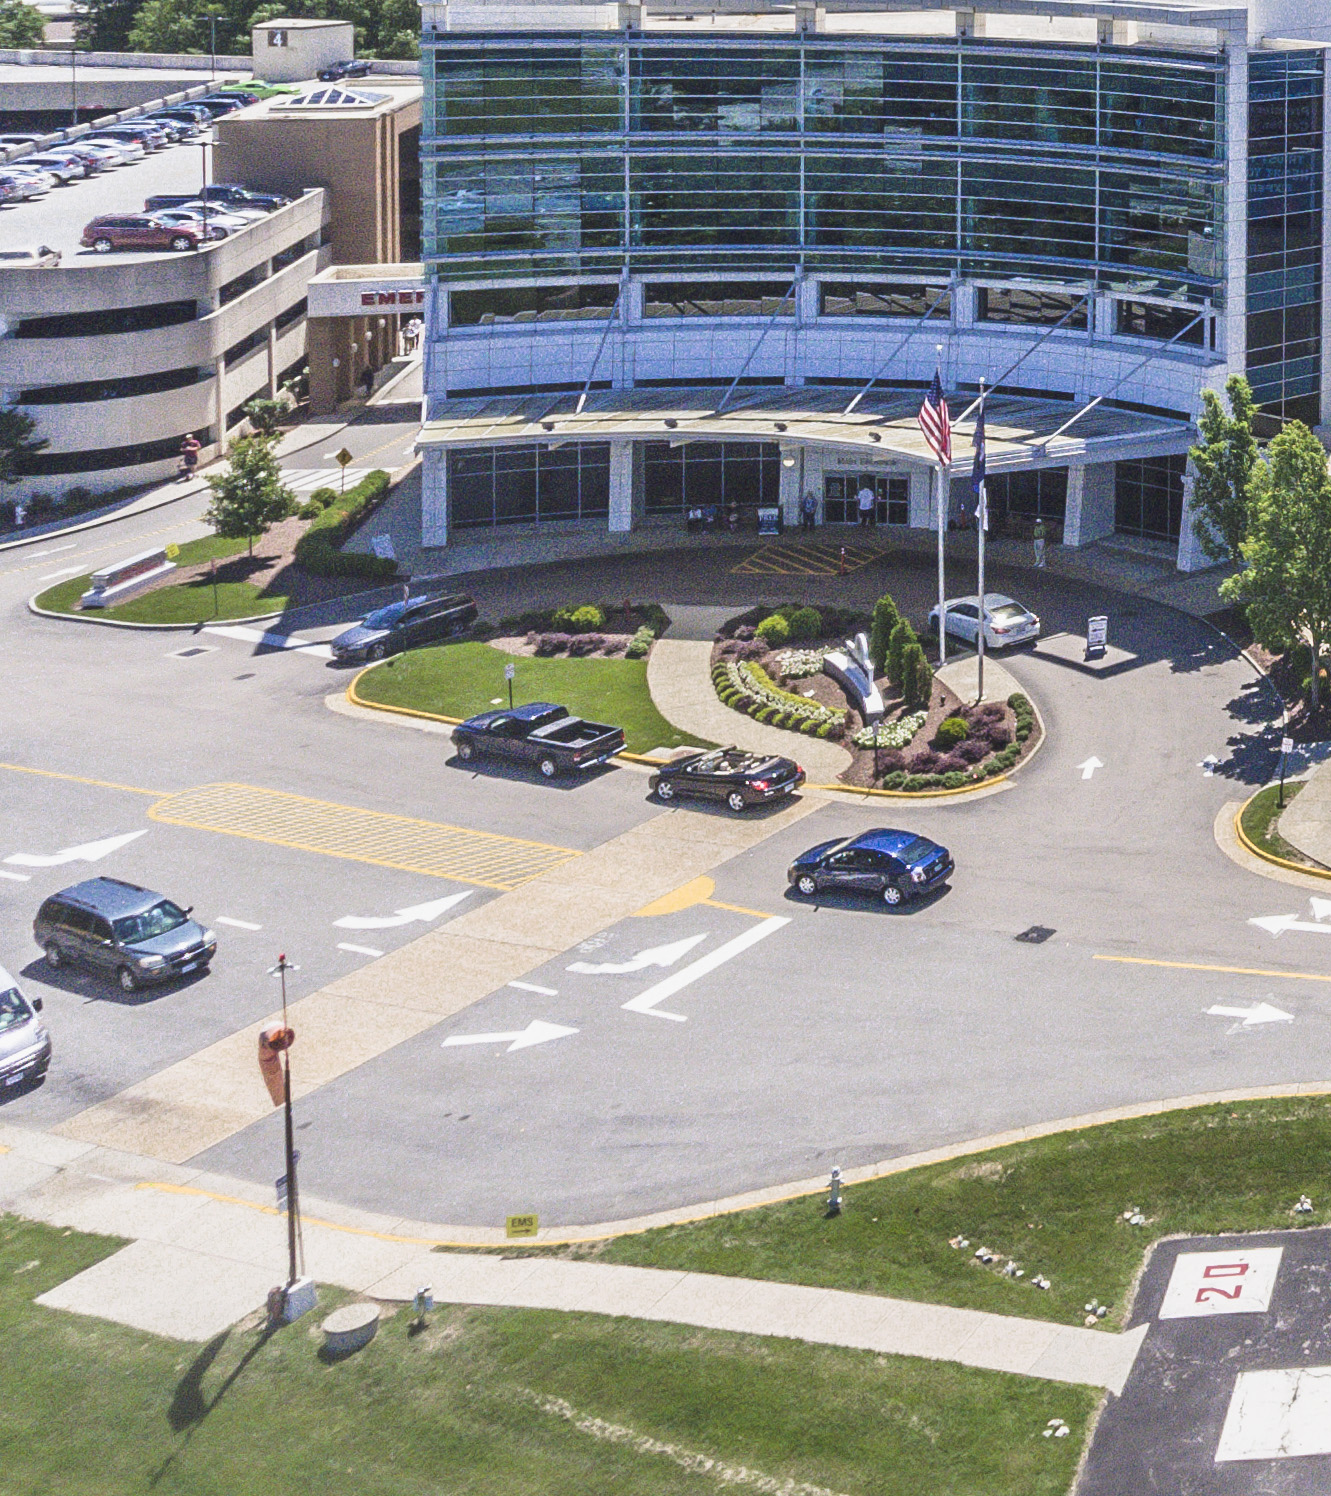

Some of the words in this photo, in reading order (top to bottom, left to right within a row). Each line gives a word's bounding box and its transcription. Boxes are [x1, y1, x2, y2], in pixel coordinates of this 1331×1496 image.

[273, 33, 283, 48] 4
[512, 1218, 533, 1228] EMS
[1195, 1262, 1249, 1303] 20
